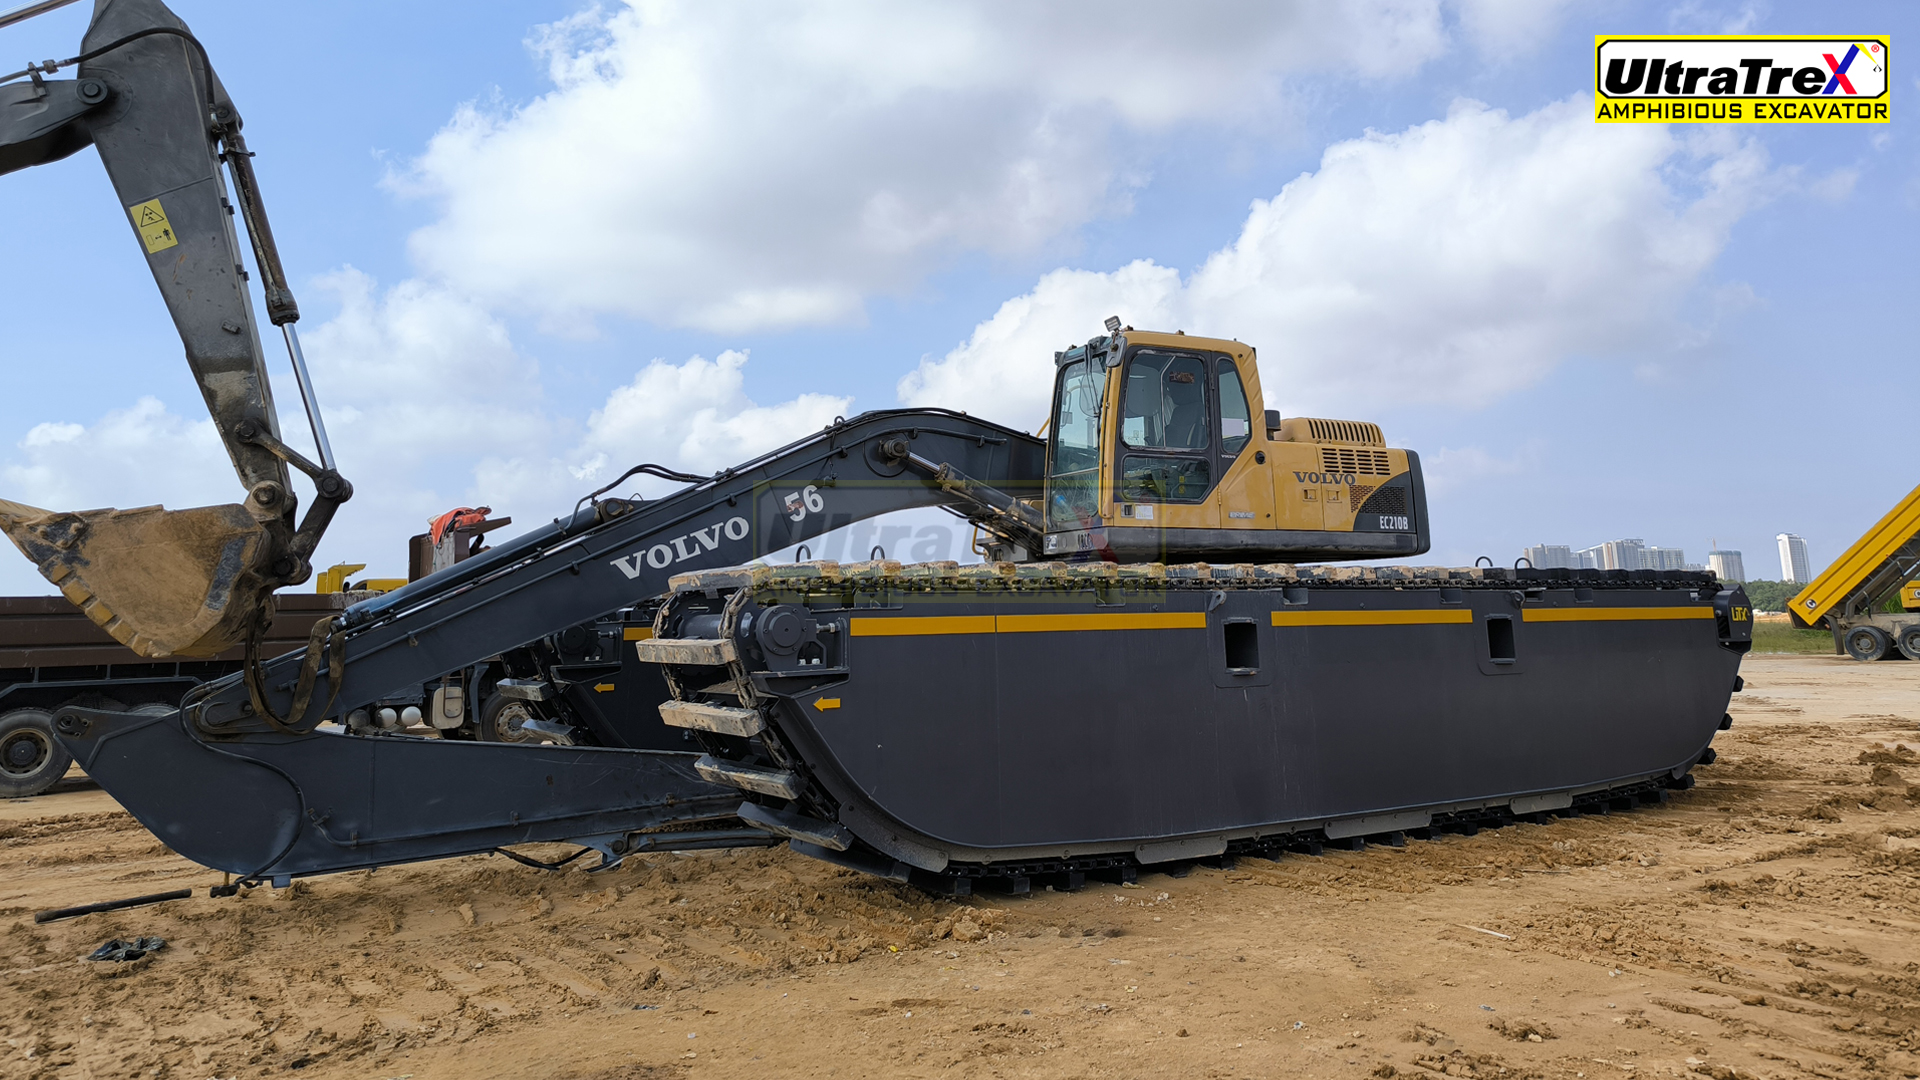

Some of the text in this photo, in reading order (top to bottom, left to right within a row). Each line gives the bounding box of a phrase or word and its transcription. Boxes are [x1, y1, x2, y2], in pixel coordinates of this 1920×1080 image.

[1293, 471, 1356, 486] VOLVO
[784, 484, 825, 522] 56
[1380, 515, 1409, 530] EC210B
[610, 516, 750, 580] VOLVO
